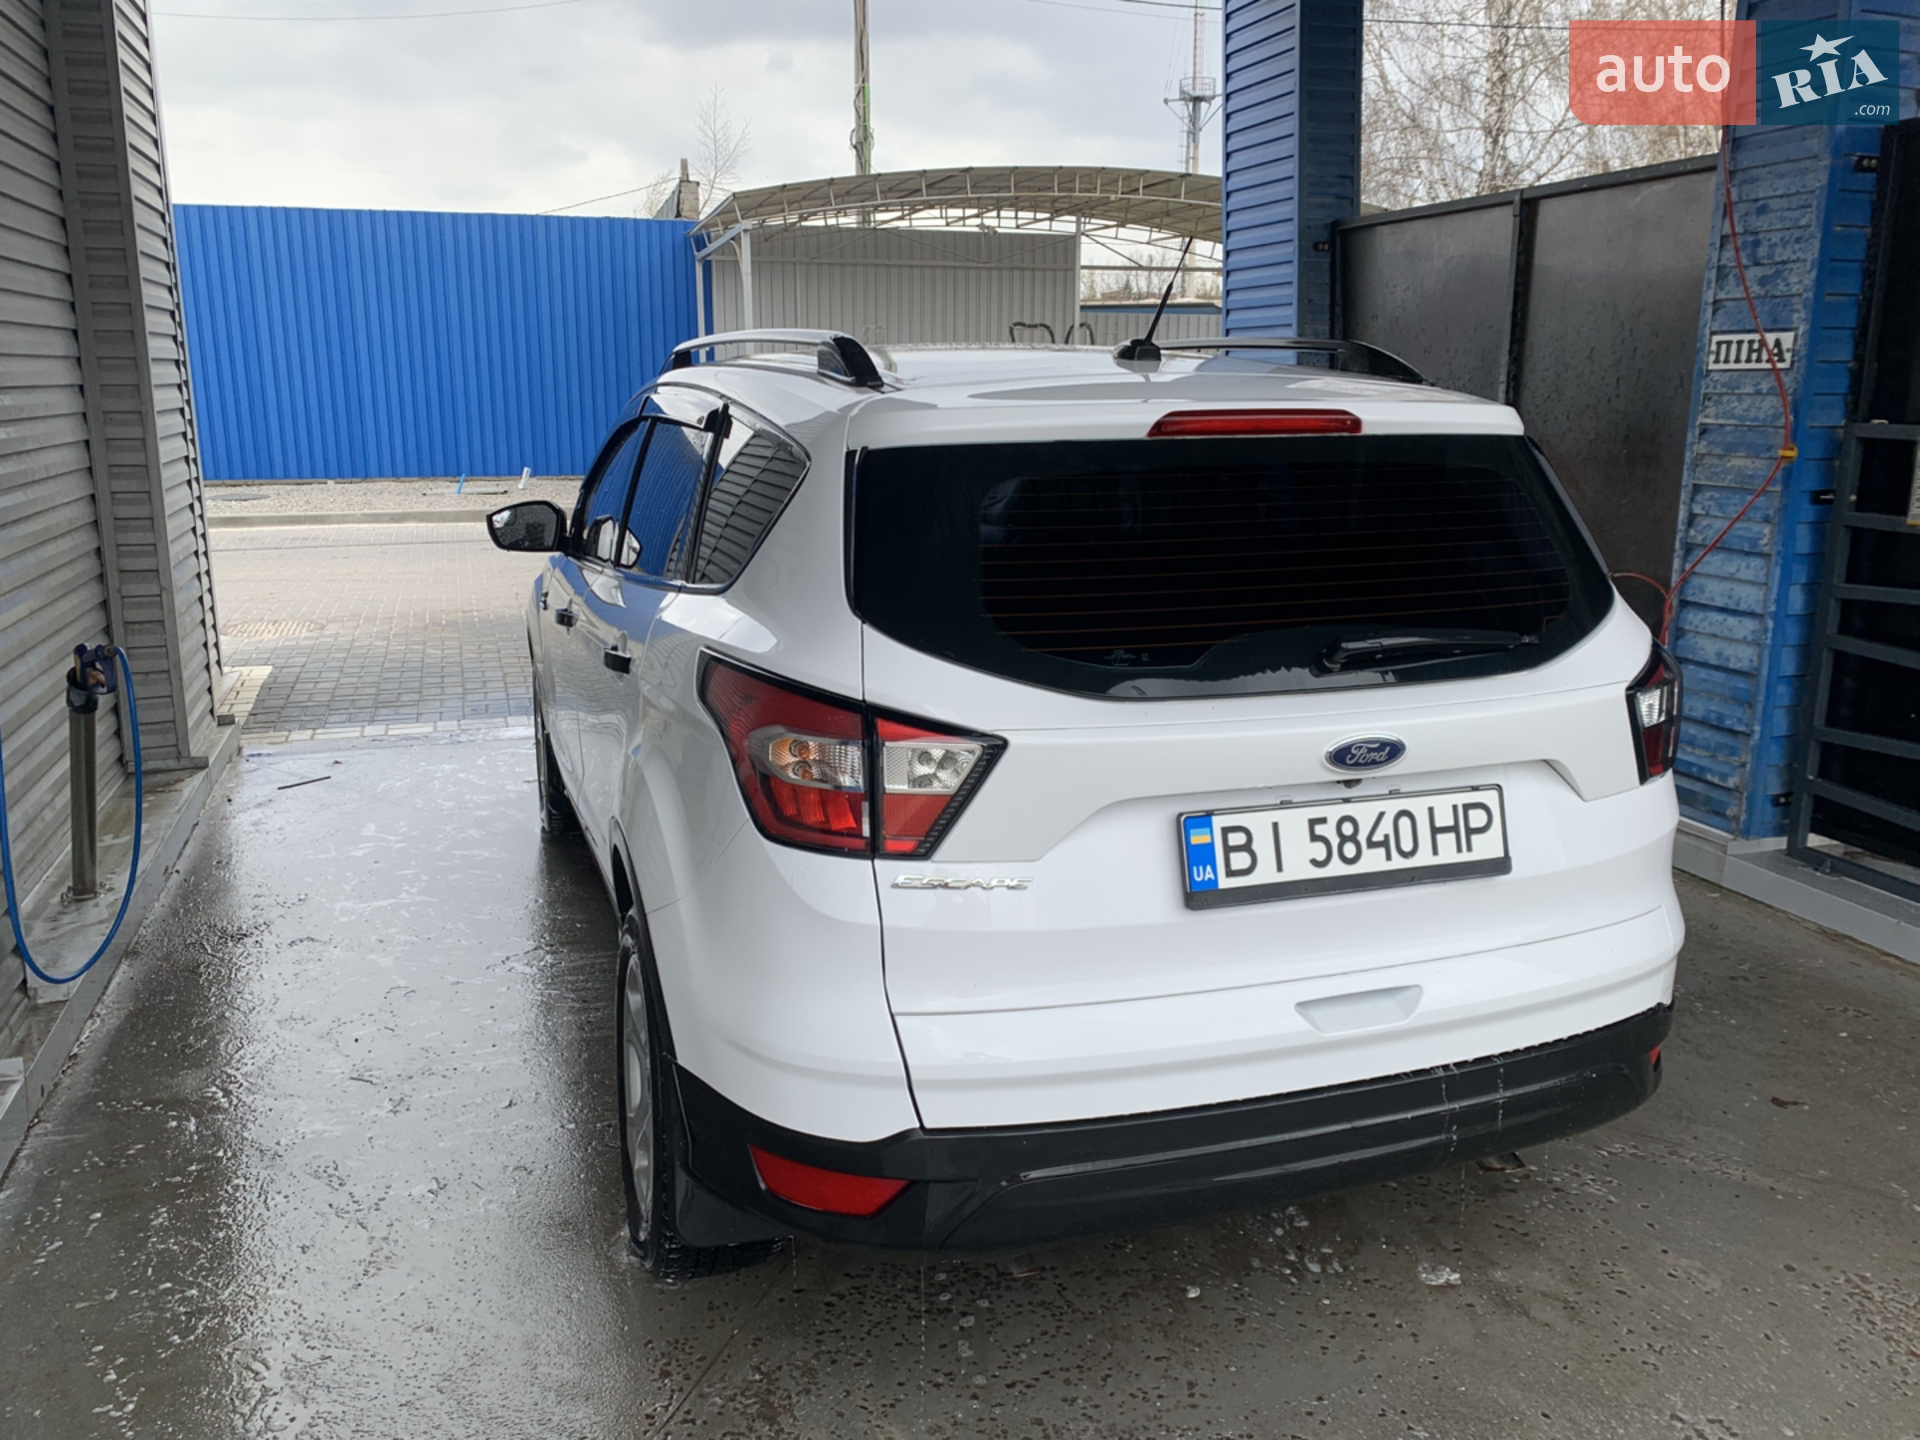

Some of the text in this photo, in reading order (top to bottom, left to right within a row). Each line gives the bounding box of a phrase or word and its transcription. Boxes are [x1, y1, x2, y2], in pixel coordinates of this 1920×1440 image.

[1713, 337, 1786, 364] ПІНА
[1345, 743, 1391, 765] Ford
[1308, 809, 1419, 868] 5840
[1428, 801, 1494, 856] HP
[1193, 866, 1216, 882] UA
